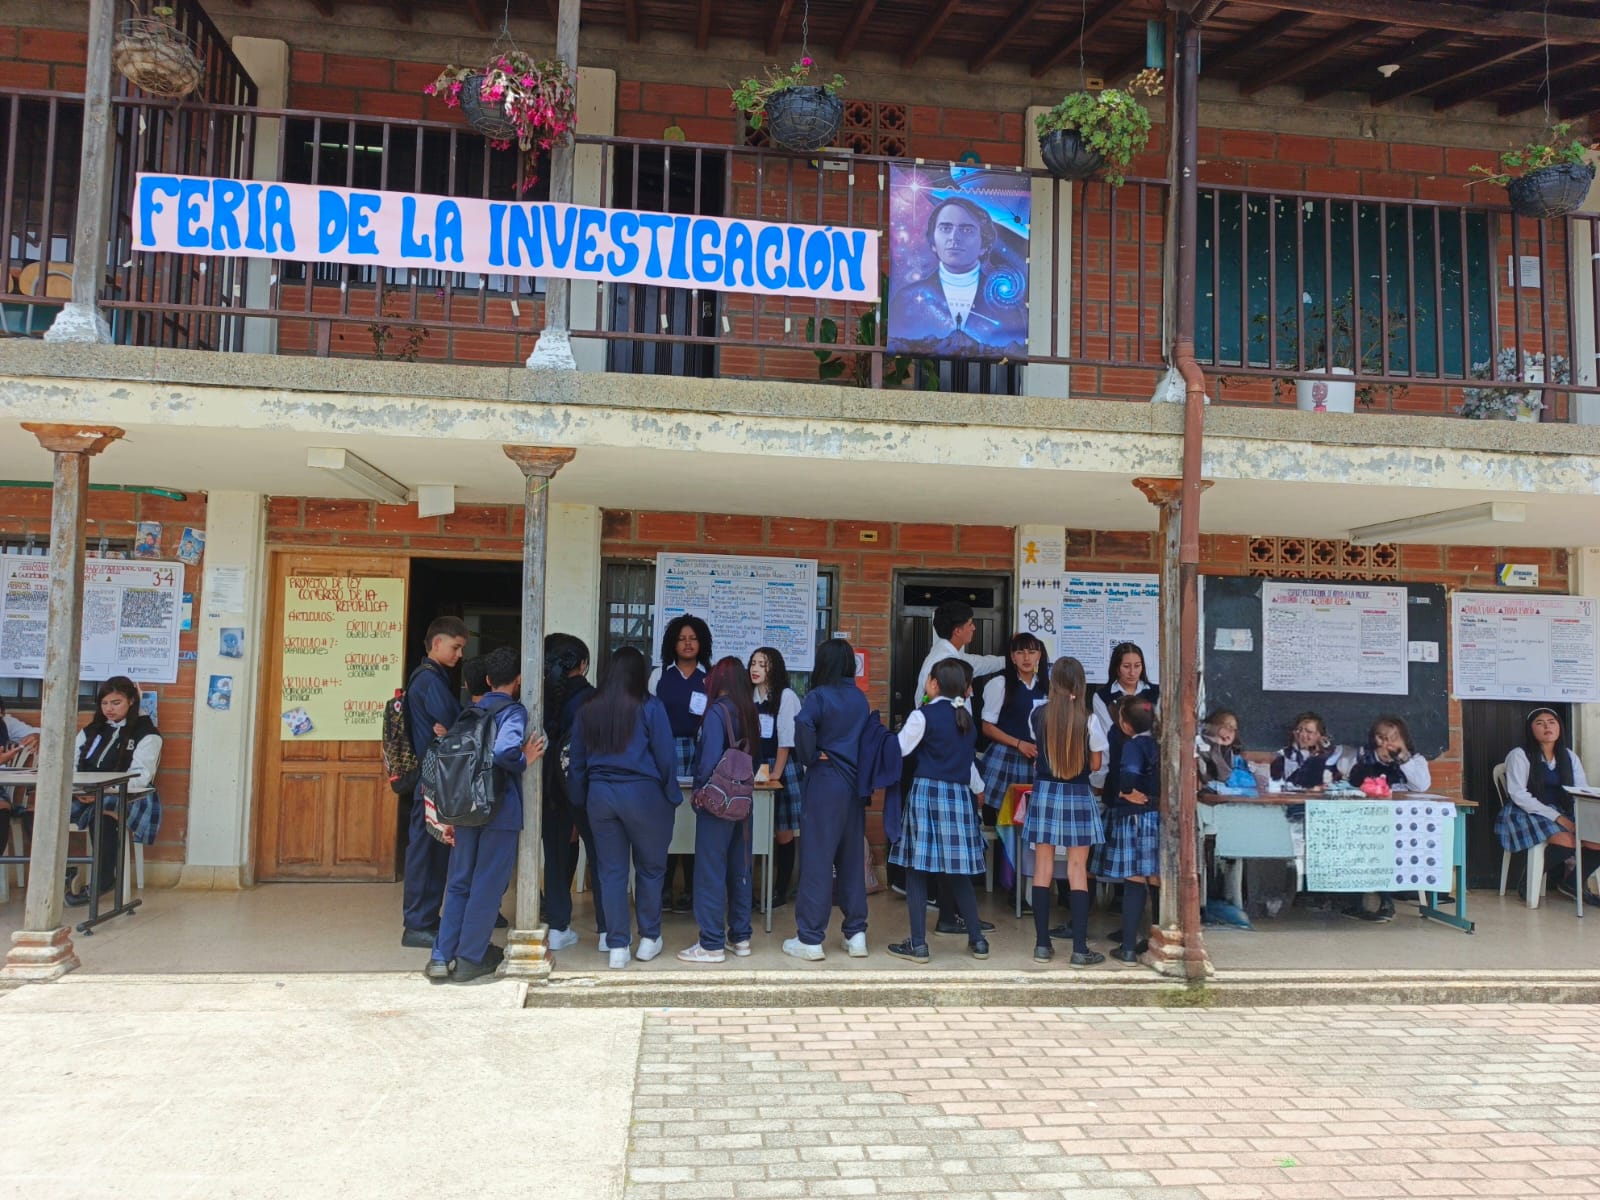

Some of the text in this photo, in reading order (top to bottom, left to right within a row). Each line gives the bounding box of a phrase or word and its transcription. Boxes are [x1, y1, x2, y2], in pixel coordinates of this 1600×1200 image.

[140, 177, 866, 292] FERIA DE LA INVESTIGACIÓN
[152, 568, 174, 587] 3-4
[332, 578, 343, 590] DE
[350, 589, 363, 601] DE
[126, 738, 135, 751] B
